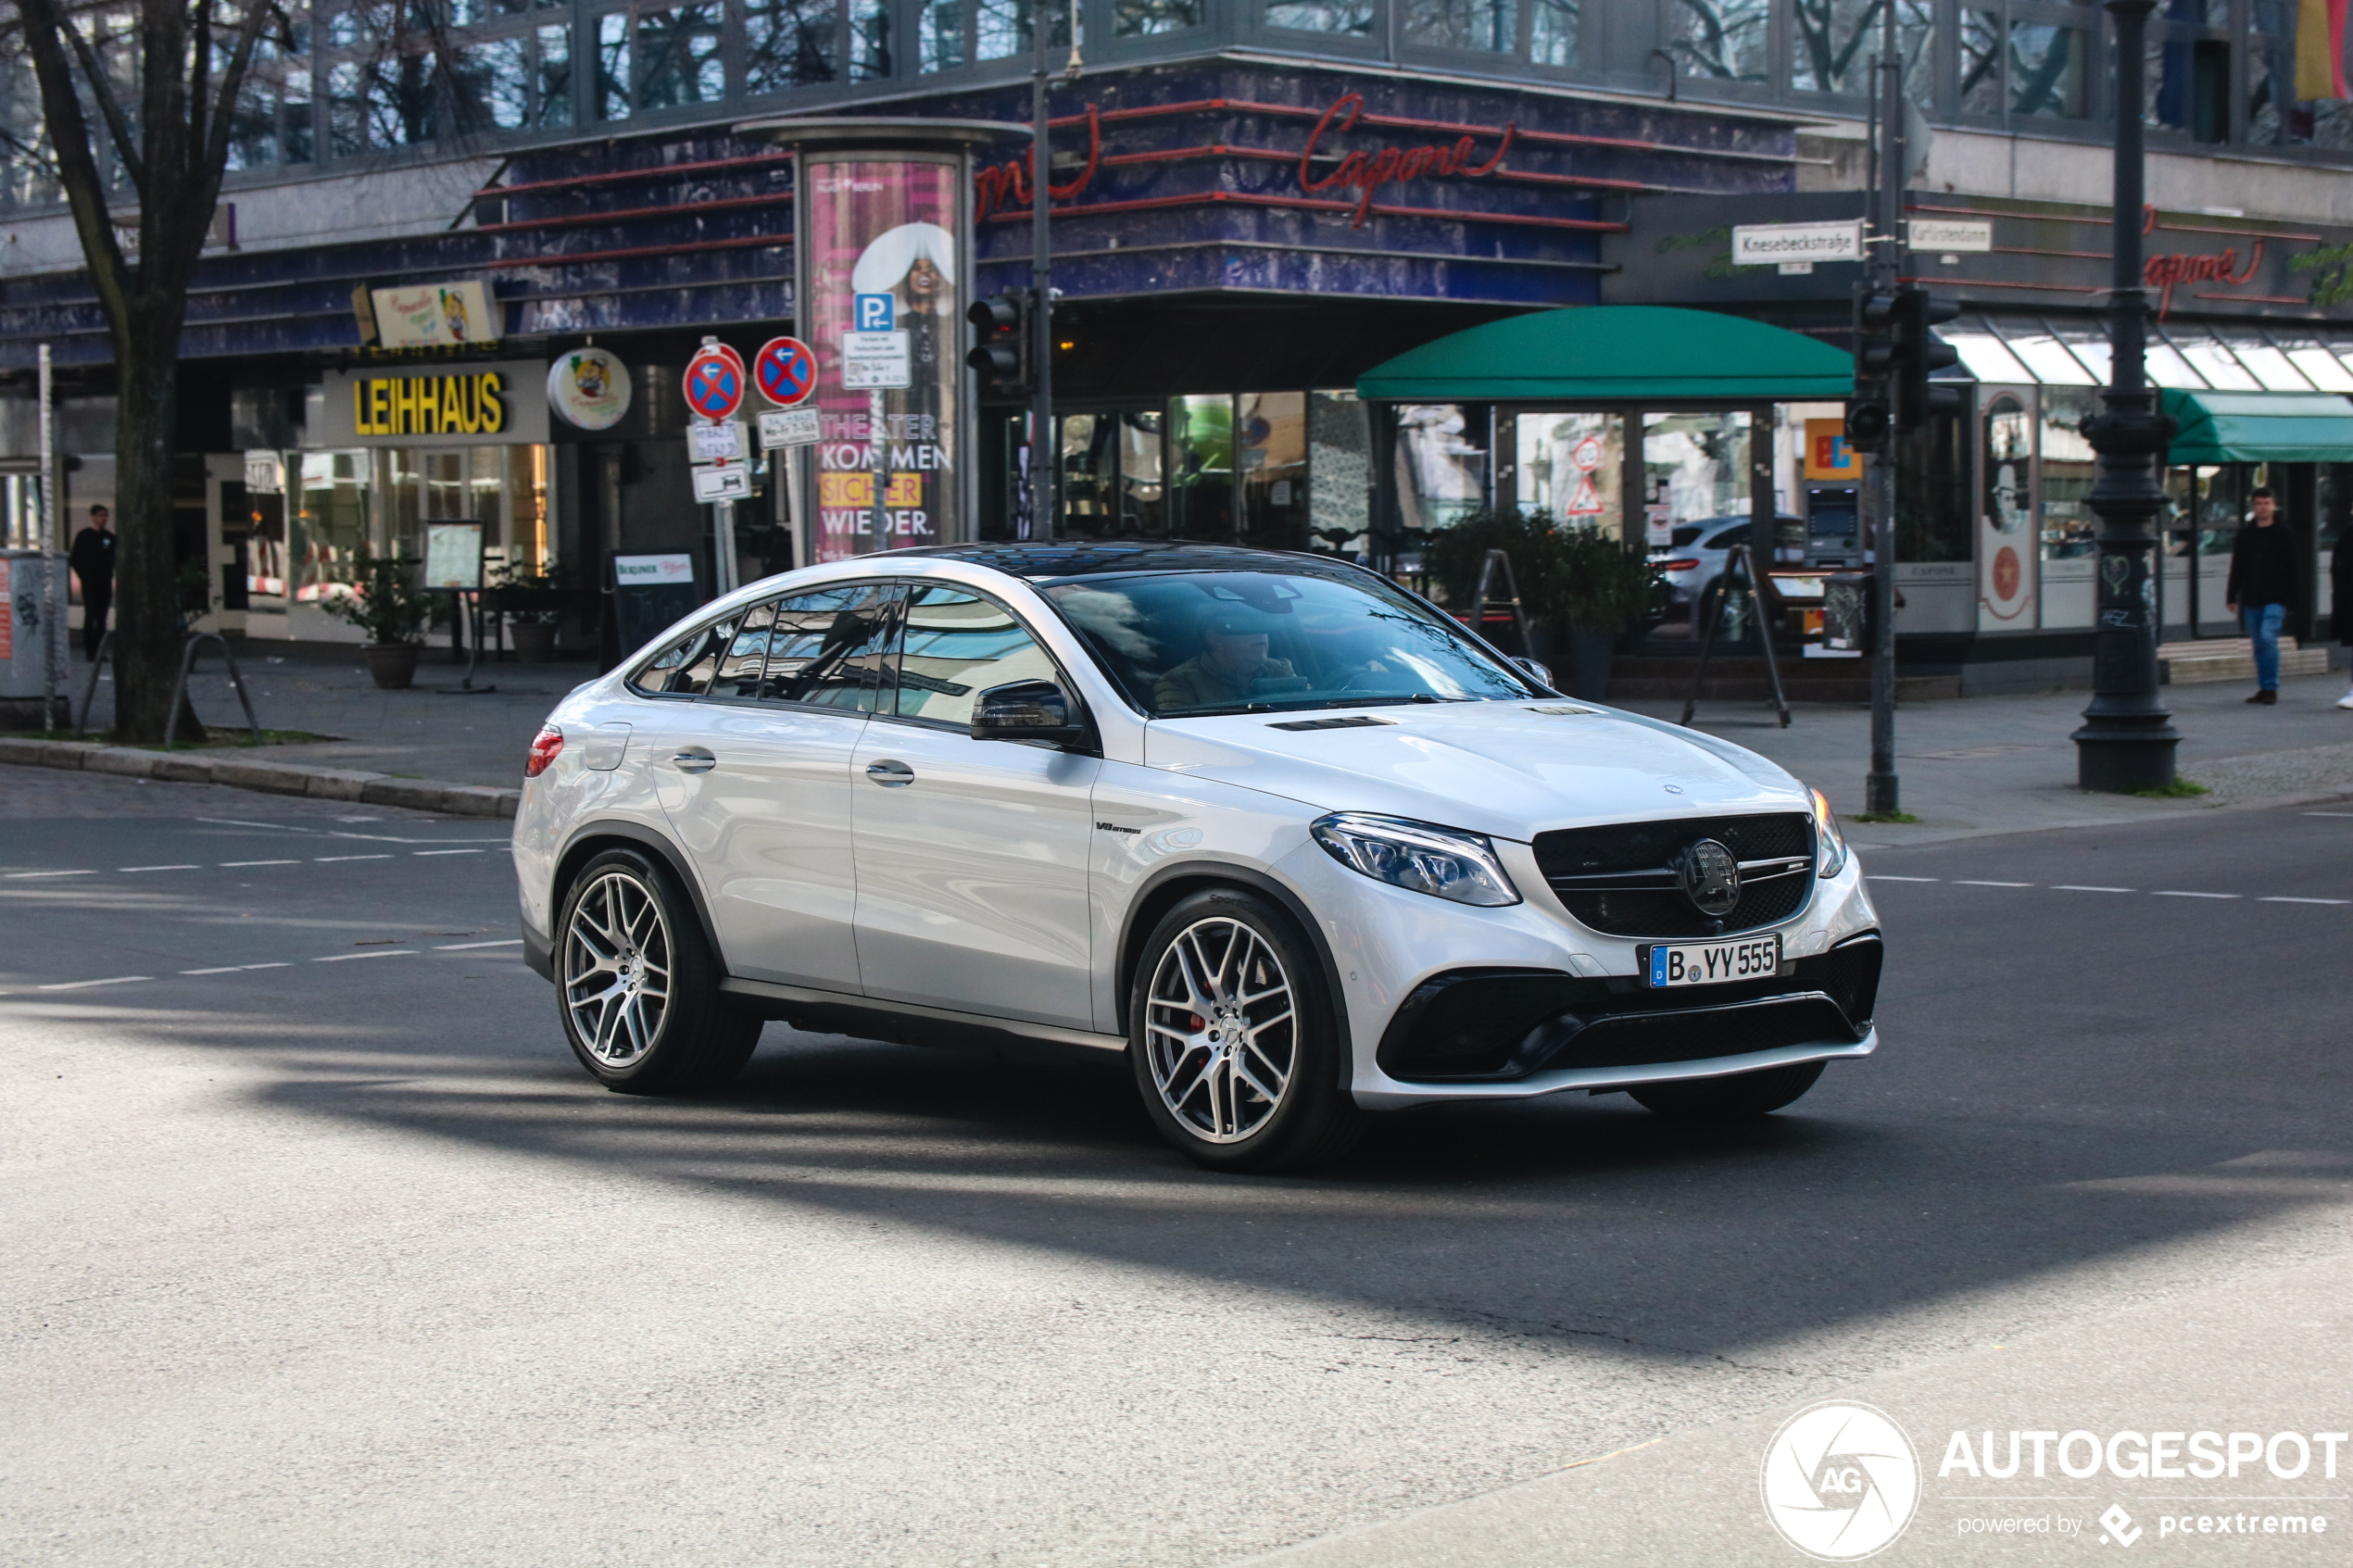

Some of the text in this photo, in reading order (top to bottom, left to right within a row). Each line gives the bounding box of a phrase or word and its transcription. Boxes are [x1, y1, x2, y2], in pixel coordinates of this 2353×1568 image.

[1300, 93, 1516, 230] Capone
[1911, 222, 1986, 243] Kurfürstendamm
[2144, 204, 2265, 323] apone
[354, 372, 502, 435] LEIHHAUS
[1655, 971, 1664, 980] D
[1668, 941, 1774, 981] B YY 555
